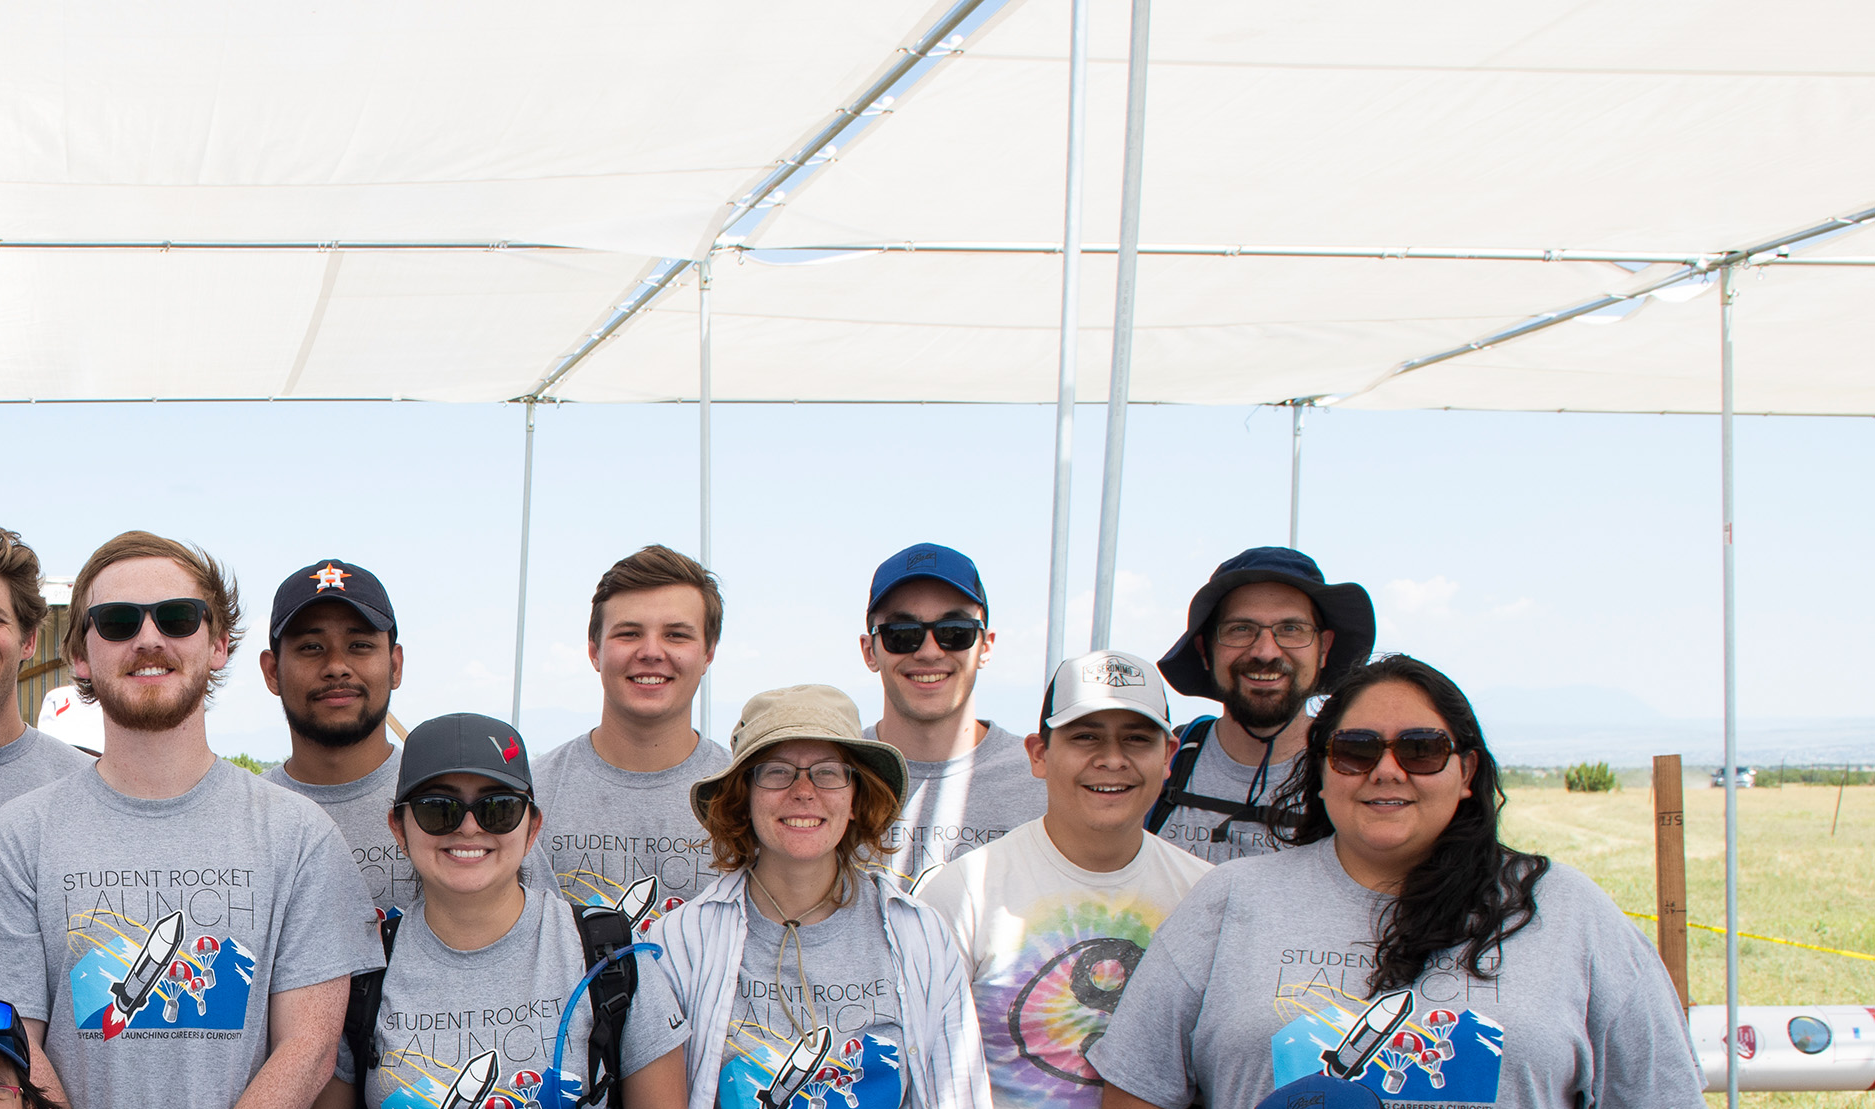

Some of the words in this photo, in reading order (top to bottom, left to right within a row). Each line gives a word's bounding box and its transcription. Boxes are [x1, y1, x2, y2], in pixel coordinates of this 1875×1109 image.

[315, 566, 345, 589] H
[551, 834, 640, 853] STUDENT
[645, 837, 712, 856] ROCKE
[881, 826, 927, 843] DENT
[352, 844, 407, 865] OCKE
[63, 870, 162, 891] STUDENT
[169, 868, 254, 888] ROCKET
[65, 888, 254, 932] LAUNCH
[1280, 949, 1375, 967] STUDEN
[737, 979, 803, 1003] UDENT
[384, 1011, 475, 1031] STUDENT
[483, 997, 562, 1027] ROCKET
[81, 1032, 104, 1040] YEARS
[121, 1031, 169, 1040] LAUNCHING
[170, 1030, 200, 1040] CAREERS
[206, 1031, 242, 1040] CURIOSITY
[381, 1021, 573, 1069] LAUNCH
